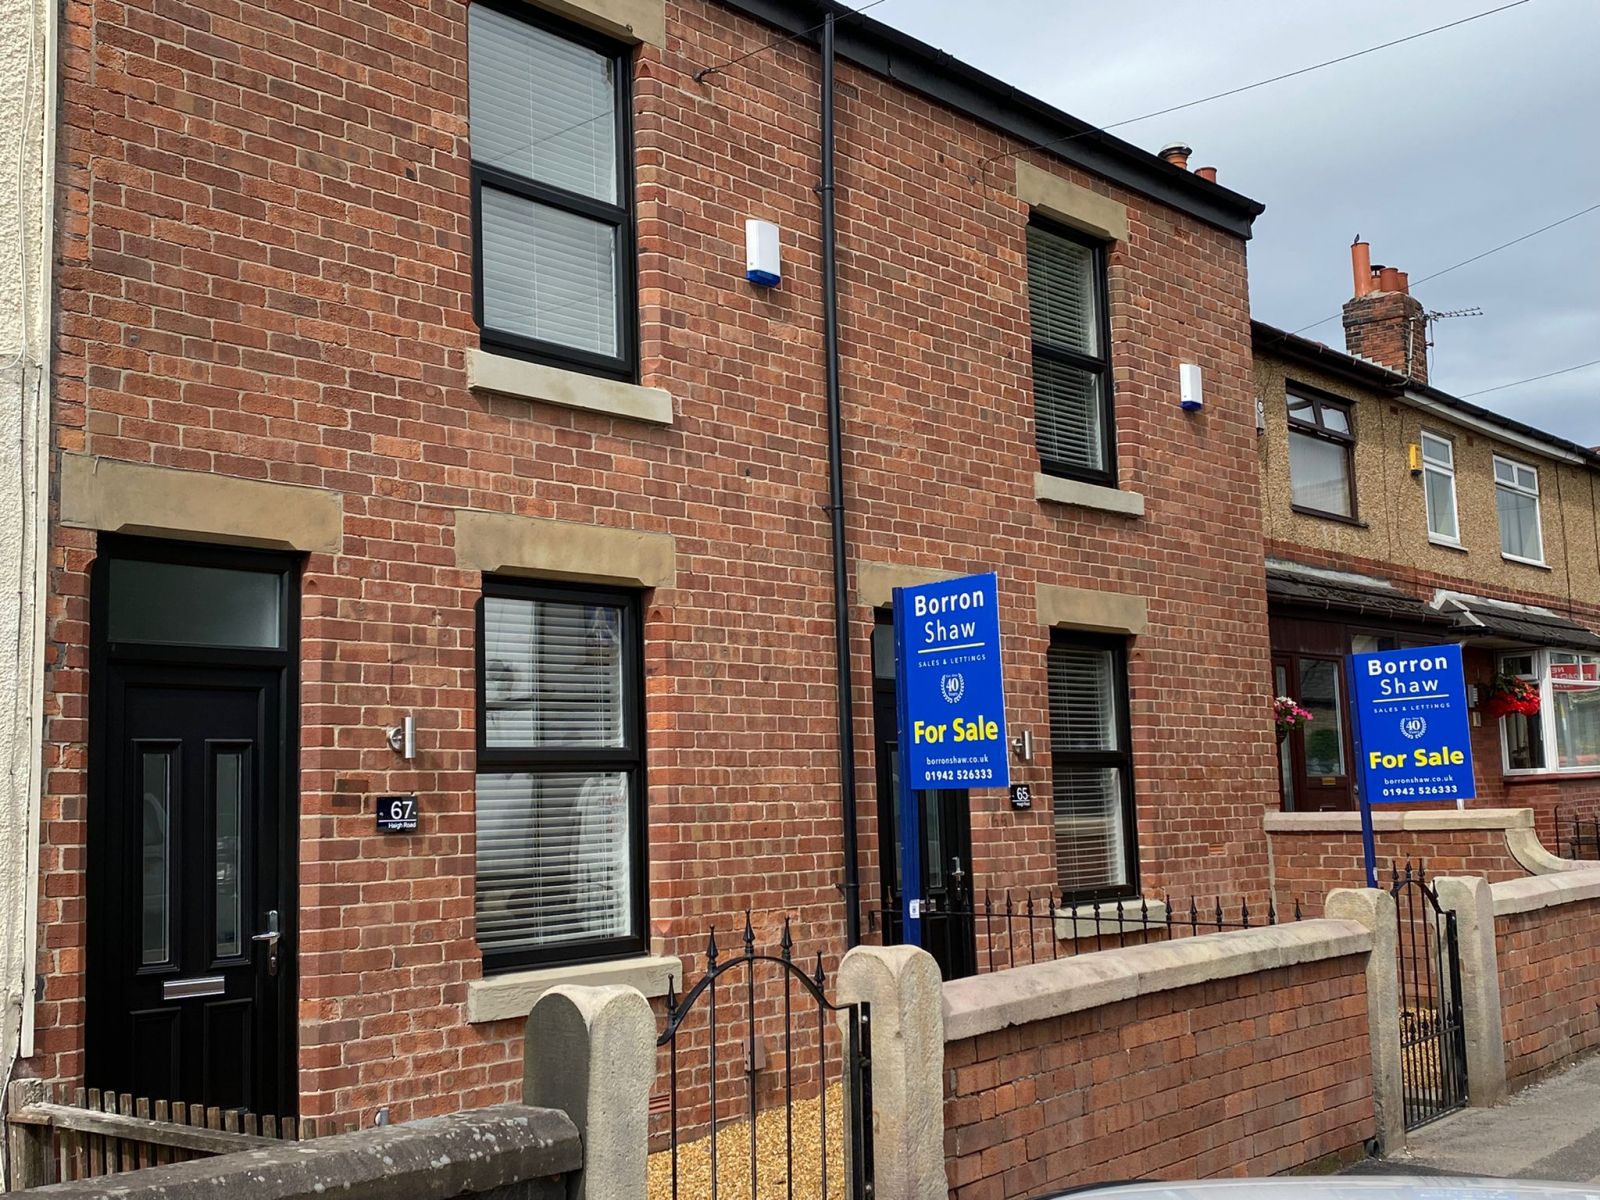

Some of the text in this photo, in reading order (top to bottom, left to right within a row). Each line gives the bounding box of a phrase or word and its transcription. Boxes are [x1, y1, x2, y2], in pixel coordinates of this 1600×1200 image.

[914, 590, 984, 617] Borron
[924, 619, 976, 644] Shaw
[918, 658, 941, 668] SALES
[950, 654, 986, 664] LETTINGS
[1367, 656, 1448, 676] Borron
[946, 677, 959, 691] 40
[1380, 677, 1439, 695] Shaw
[1374, 706, 1398, 714] SALES
[1410, 702, 1451, 711] LETTINGS
[914, 715, 998, 744] For Sale
[1405, 719, 1421, 731] 40
[926, 754, 989, 765] borronshaw.co.uk
[1369, 746, 1464, 769] For Sale
[925, 768, 993, 781] 01942 526333
[1384, 774, 1454, 785] borronshaw.co.uk
[1016, 787, 1028, 800] 65
[1382, 785, 1458, 796] 01942 526333
[390, 801, 413, 820] 67
